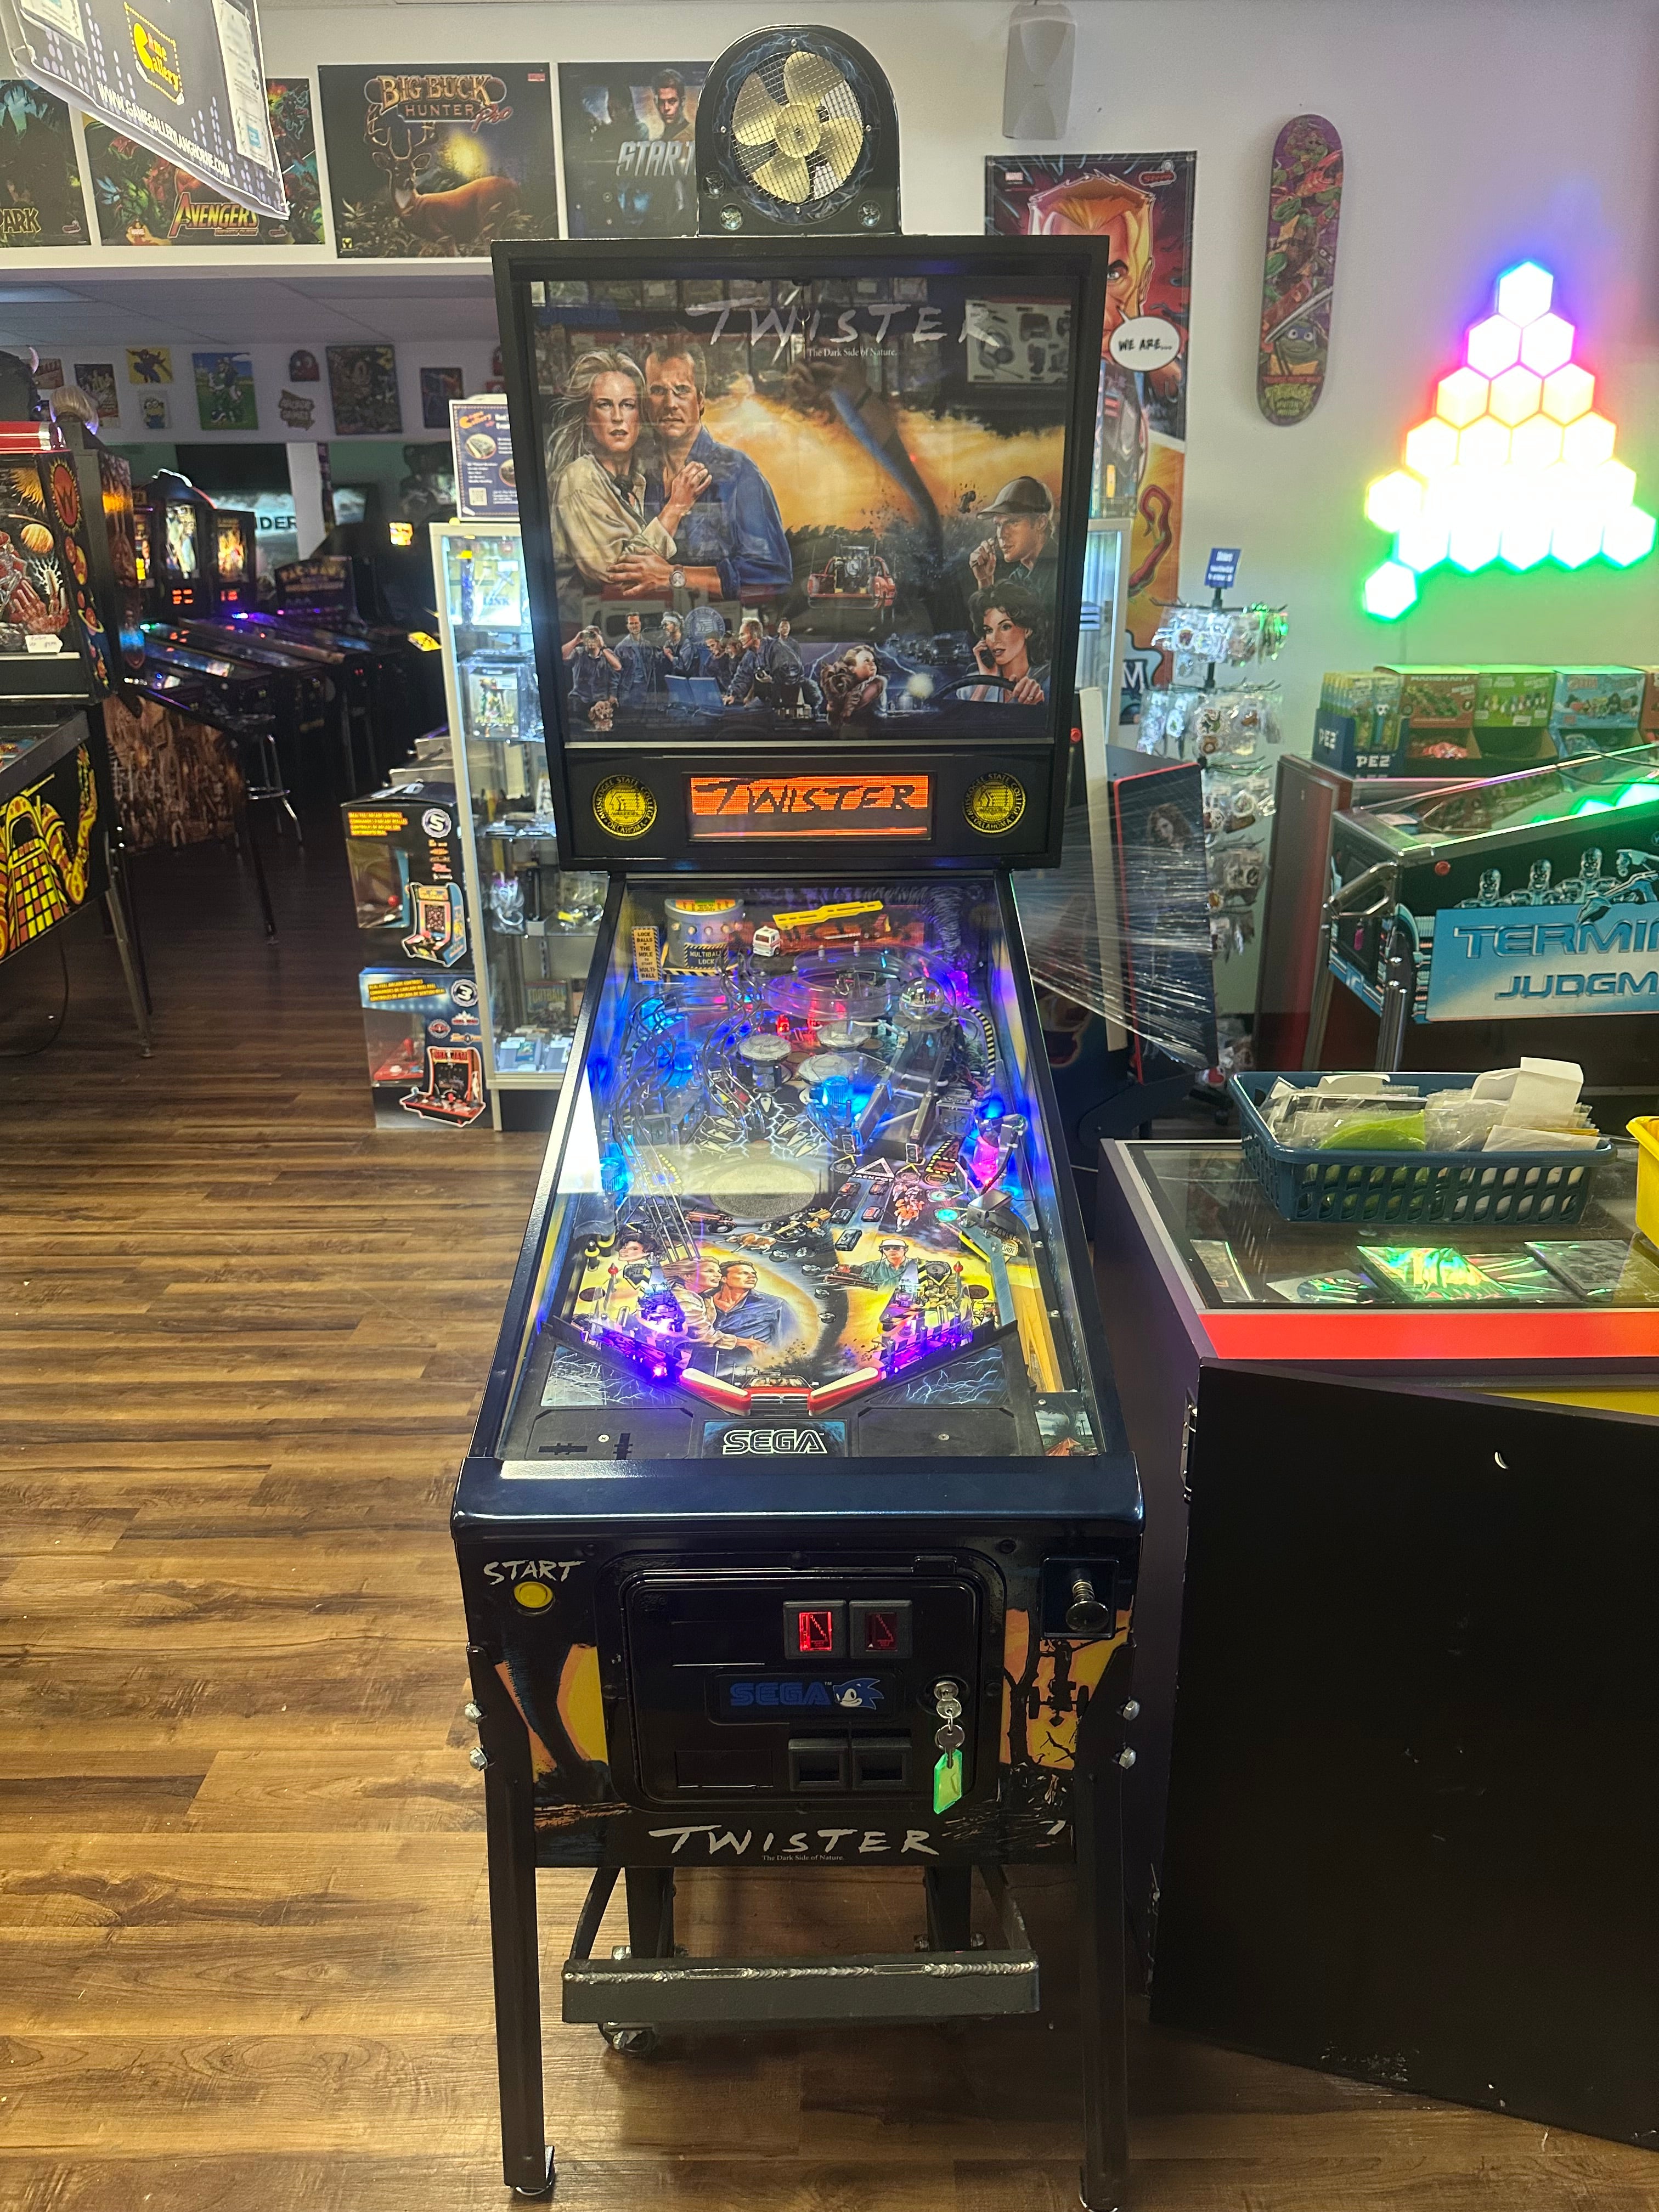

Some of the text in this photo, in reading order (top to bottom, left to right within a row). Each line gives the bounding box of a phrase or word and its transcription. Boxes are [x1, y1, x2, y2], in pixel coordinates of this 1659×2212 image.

[377, 75, 492, 115] BIG BUCK
[405, 105, 475, 117] HUNTER
[616, 140, 683, 176] STAR
[168, 192, 258, 237] AVENGERS
[685, 296, 1001, 348] TWISTER
[808, 347, 822, 357] The
[823, 347, 842, 357] Dark
[843, 347, 859, 357] Side
[870, 347, 897, 356] Nature.
[1119, 339, 1134, 351] WE
[1356, 754, 1391, 768] PEZ
[695, 778, 918, 815] TWISTER
[1453, 918, 1659, 959] TERMI
[457, 985, 473, 1001] 3
[851, 1173, 893, 1182] JACKPOT
[723, 1429, 827, 1455] SEGA
[484, 1560, 585, 1585] START
[730, 1681, 831, 1706] SEGA
[648, 1825, 940, 1855] TWISTER
